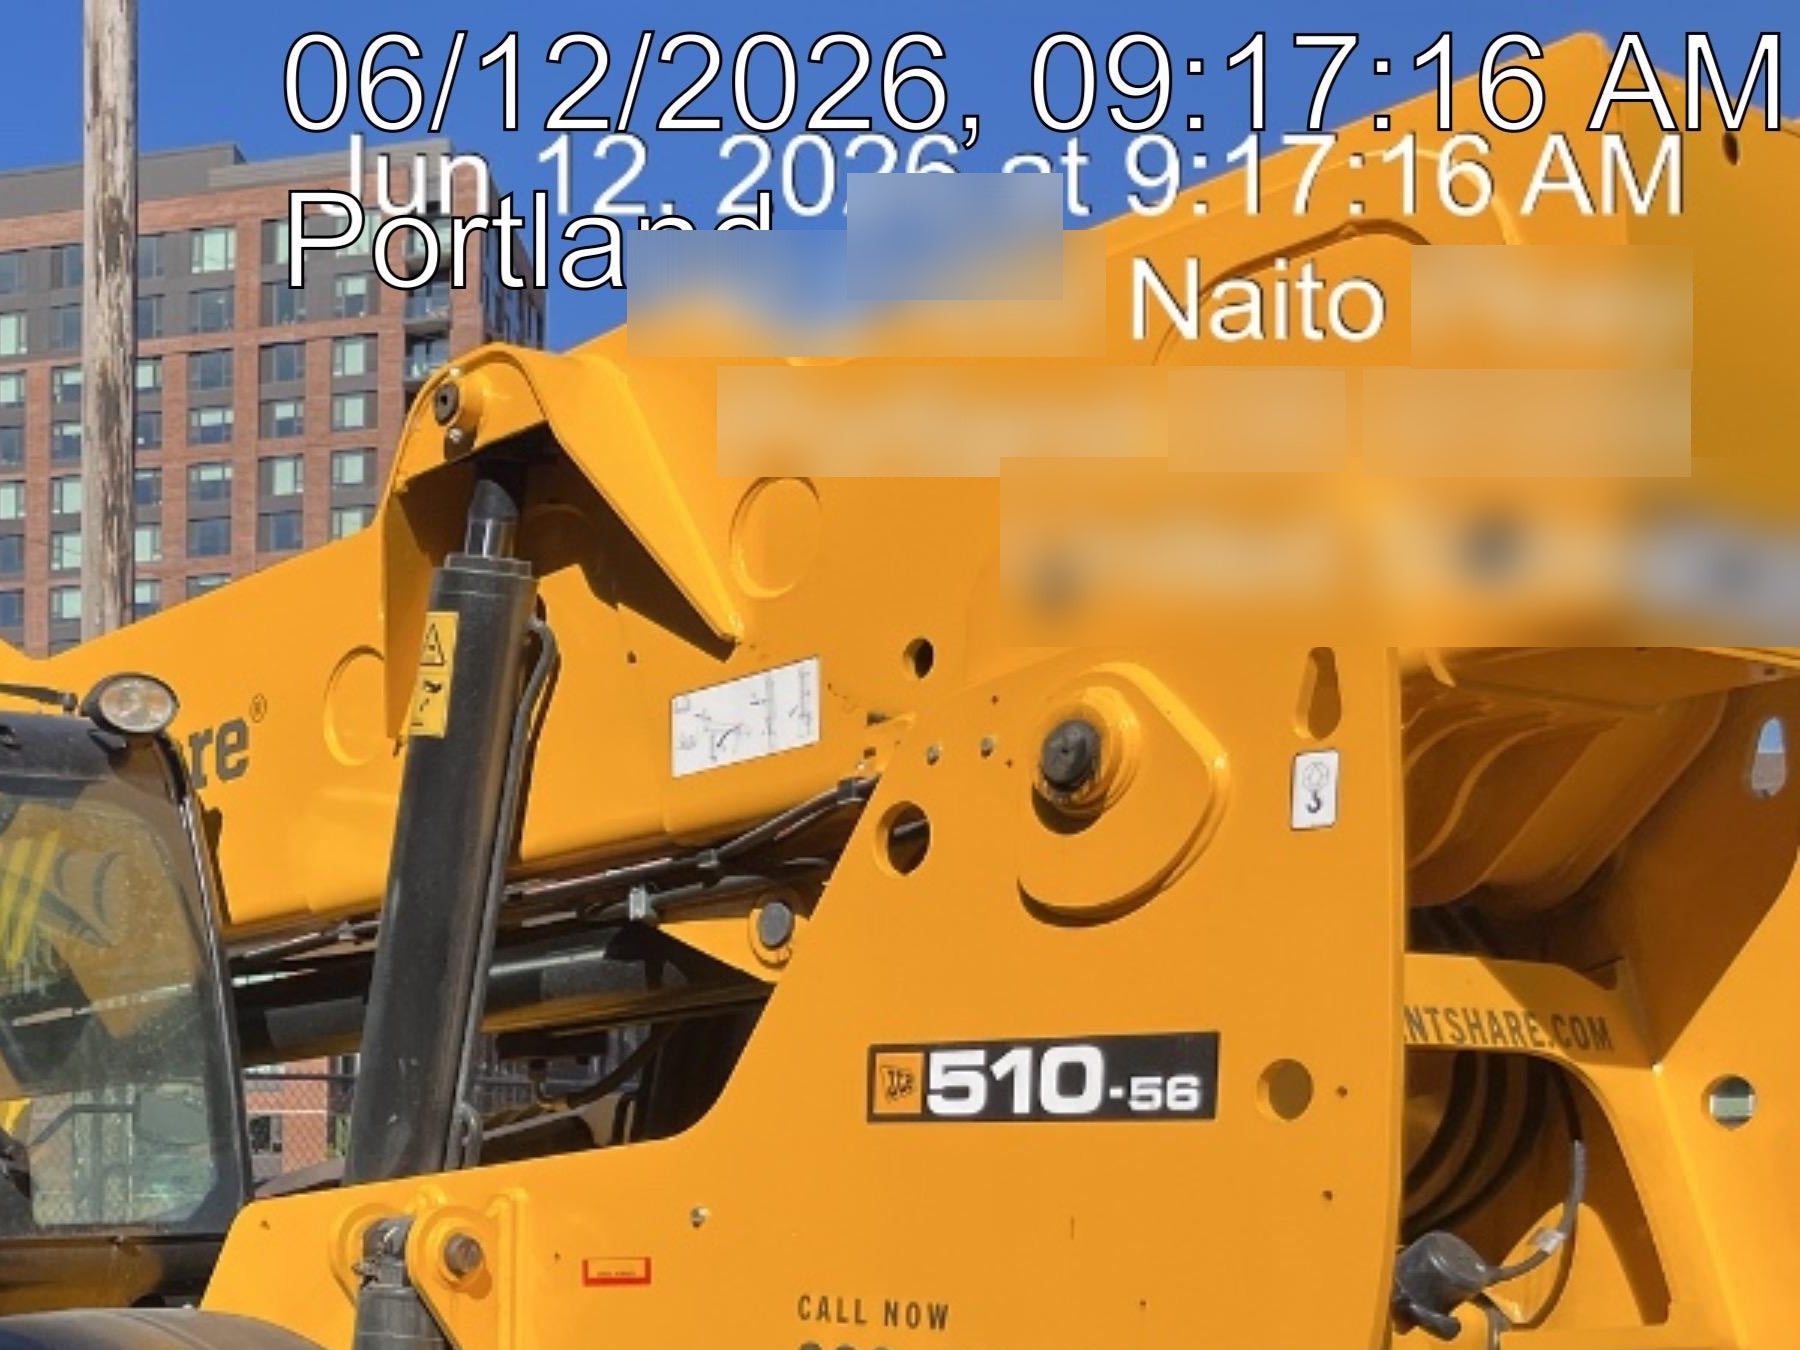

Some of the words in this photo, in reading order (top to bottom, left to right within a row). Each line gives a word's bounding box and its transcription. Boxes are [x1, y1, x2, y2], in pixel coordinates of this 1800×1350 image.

[1403, 1005, 1615, 1051] NTSHARE.COM
[926, 1044, 1200, 1116] 510-56
[797, 1295, 868, 1325] CALL
[884, 1299, 949, 1330] NOW
